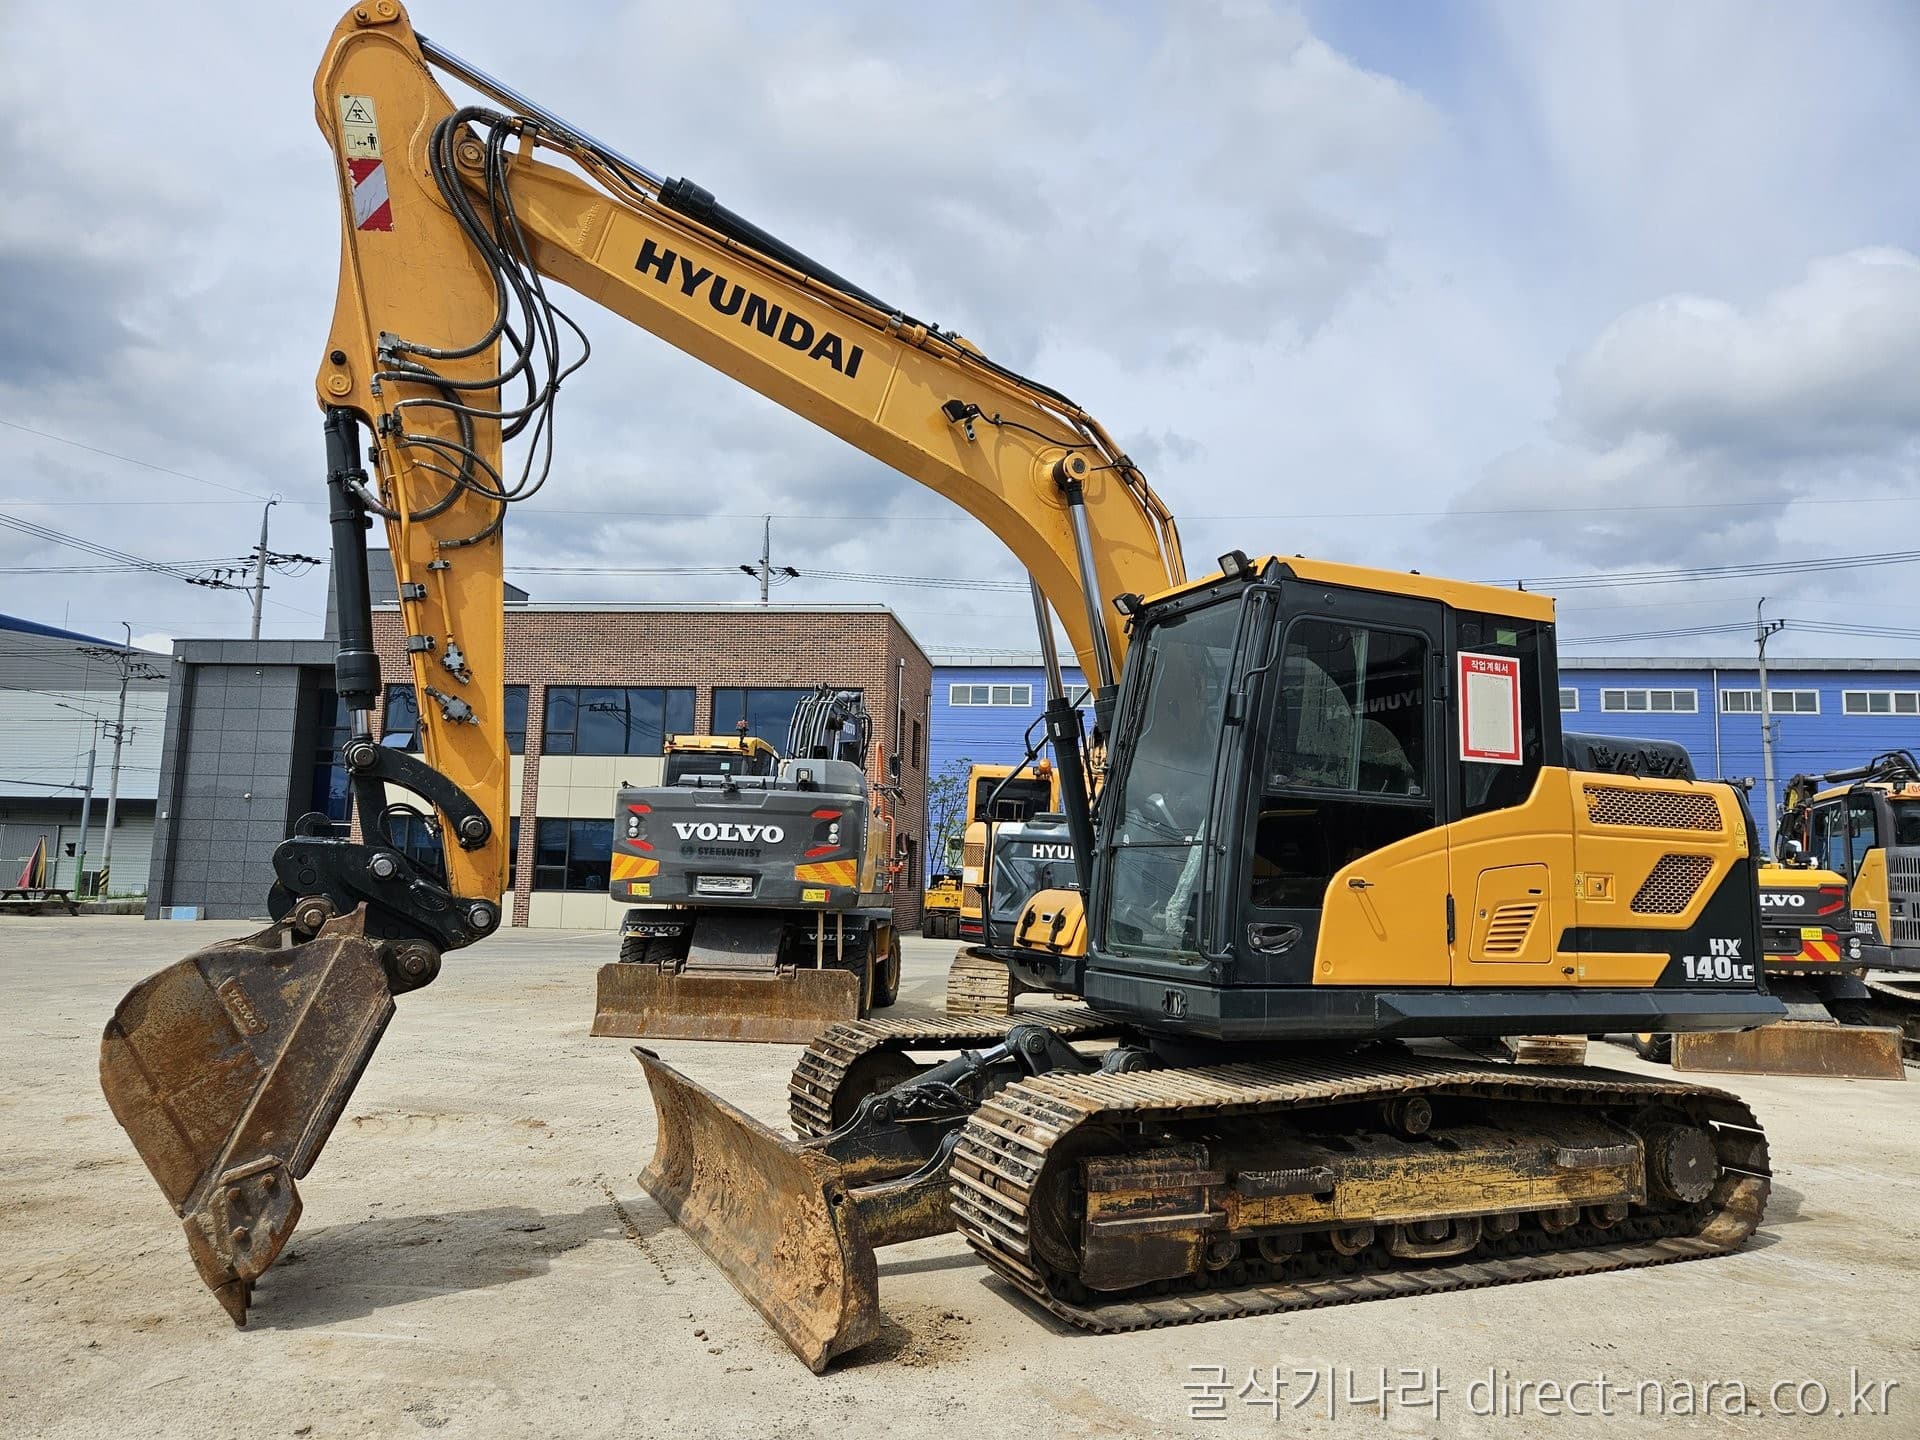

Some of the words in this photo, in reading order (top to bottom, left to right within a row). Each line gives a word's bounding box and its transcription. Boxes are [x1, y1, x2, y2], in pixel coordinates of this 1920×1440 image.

[634, 238, 864, 379] HYUNDAI
[672, 822, 785, 843] VOLVO
[697, 846, 762, 858] STEELWRIST
[626, 925, 680, 934] VOLVO
[1709, 938, 1740, 957] HX
